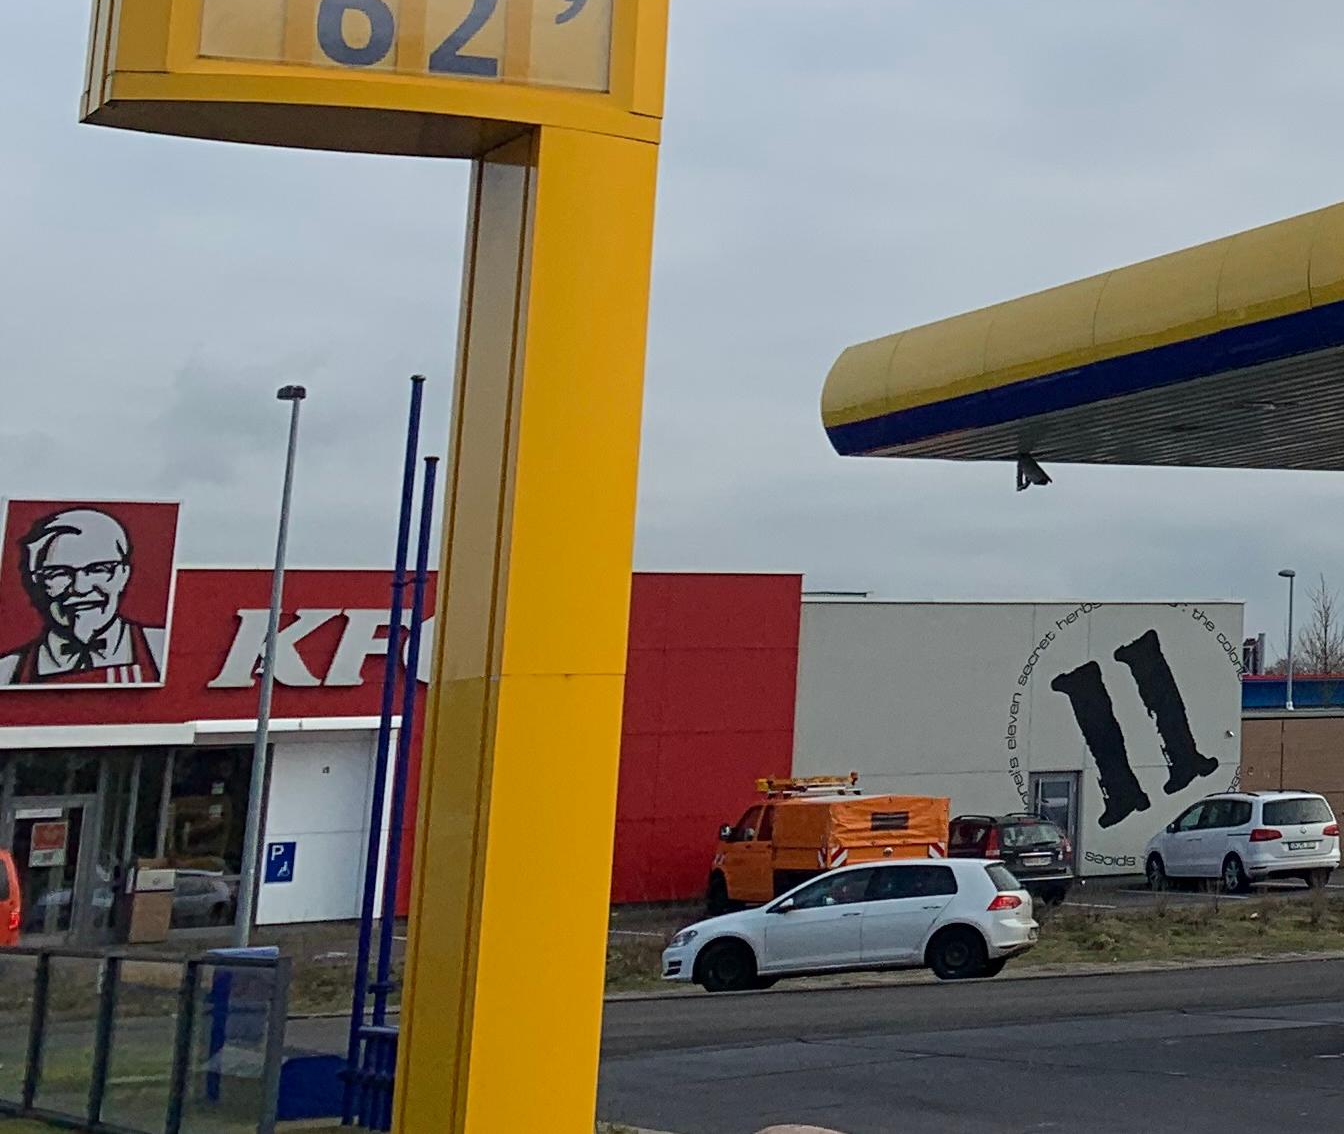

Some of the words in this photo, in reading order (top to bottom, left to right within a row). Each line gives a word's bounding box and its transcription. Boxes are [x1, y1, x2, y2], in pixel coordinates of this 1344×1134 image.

[1192, 609, 1215, 632] the
[1007, 692, 1022, 751] eleven
[1018, 631, 1056, 687] secret
[271, 845, 284, 861] P
[1084, 850, 1136, 866] spices
